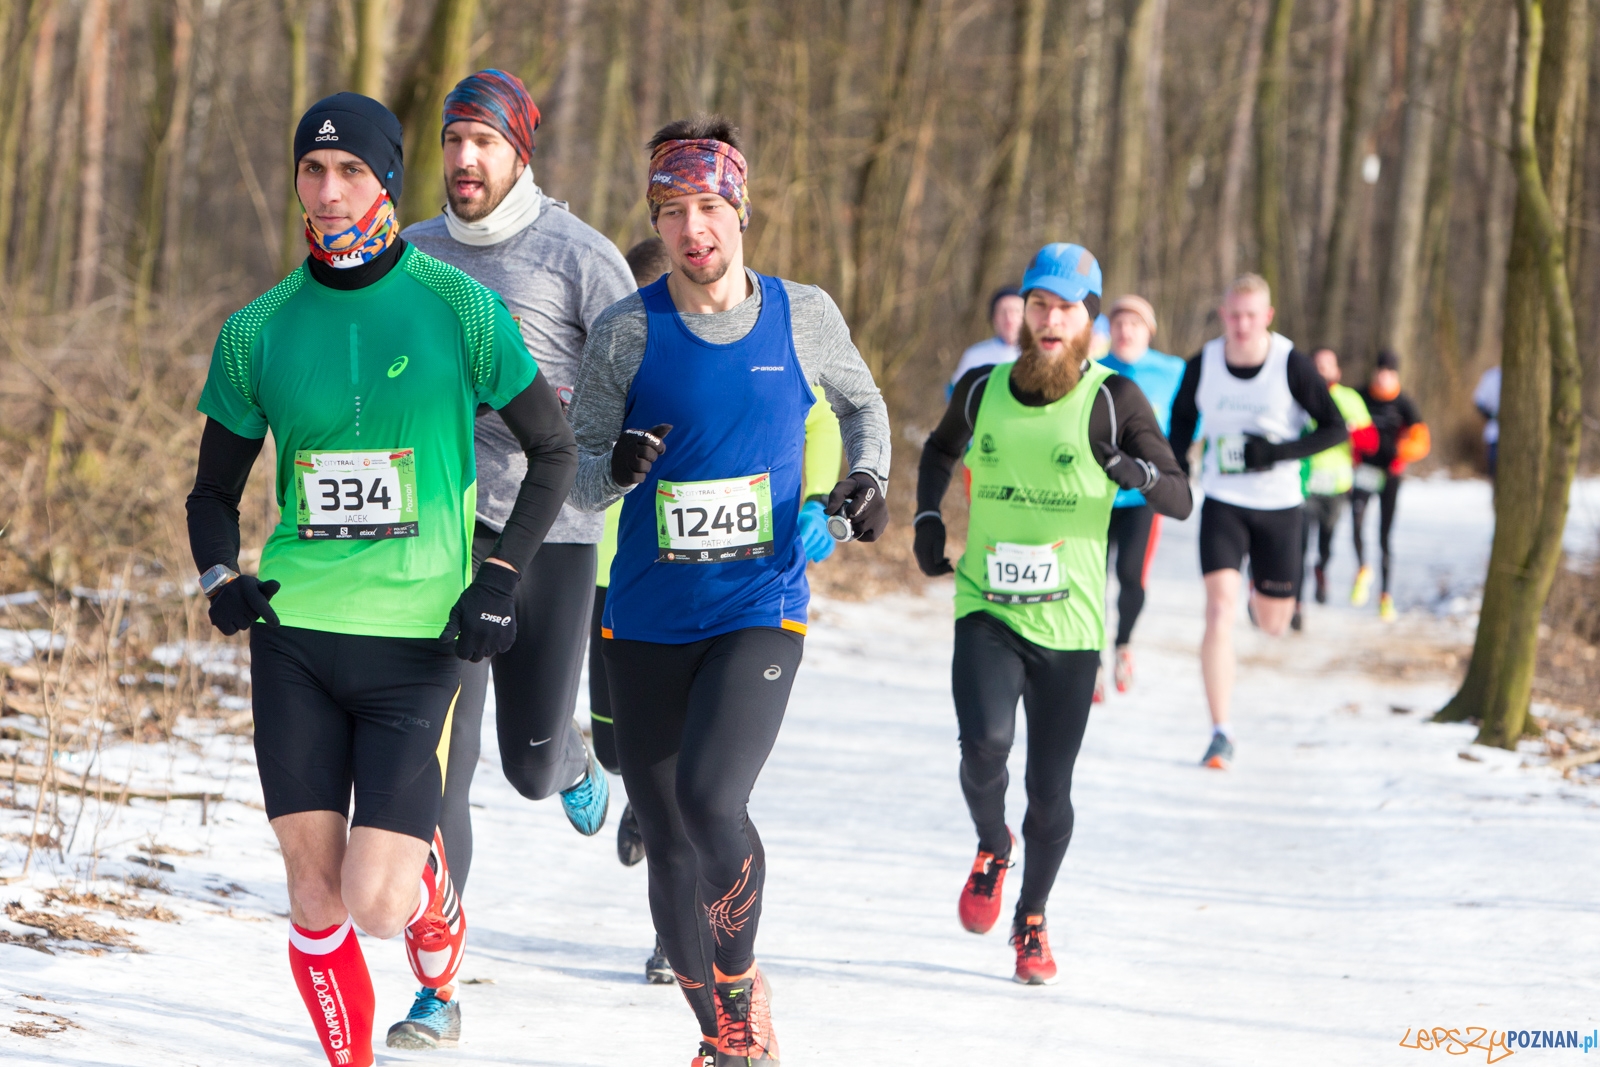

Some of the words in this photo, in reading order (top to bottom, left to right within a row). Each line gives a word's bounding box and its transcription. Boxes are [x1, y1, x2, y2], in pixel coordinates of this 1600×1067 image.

[315, 134, 339, 142] odlo
[318, 477, 392, 512] 334
[405, 483, 414, 513] Poznań
[344, 514, 369, 523] JACEK
[671, 502, 758, 538] 1248
[701, 538, 733, 548] PATRYK
[995, 561, 1052, 584] 1947
[480, 612, 502, 624] asics
